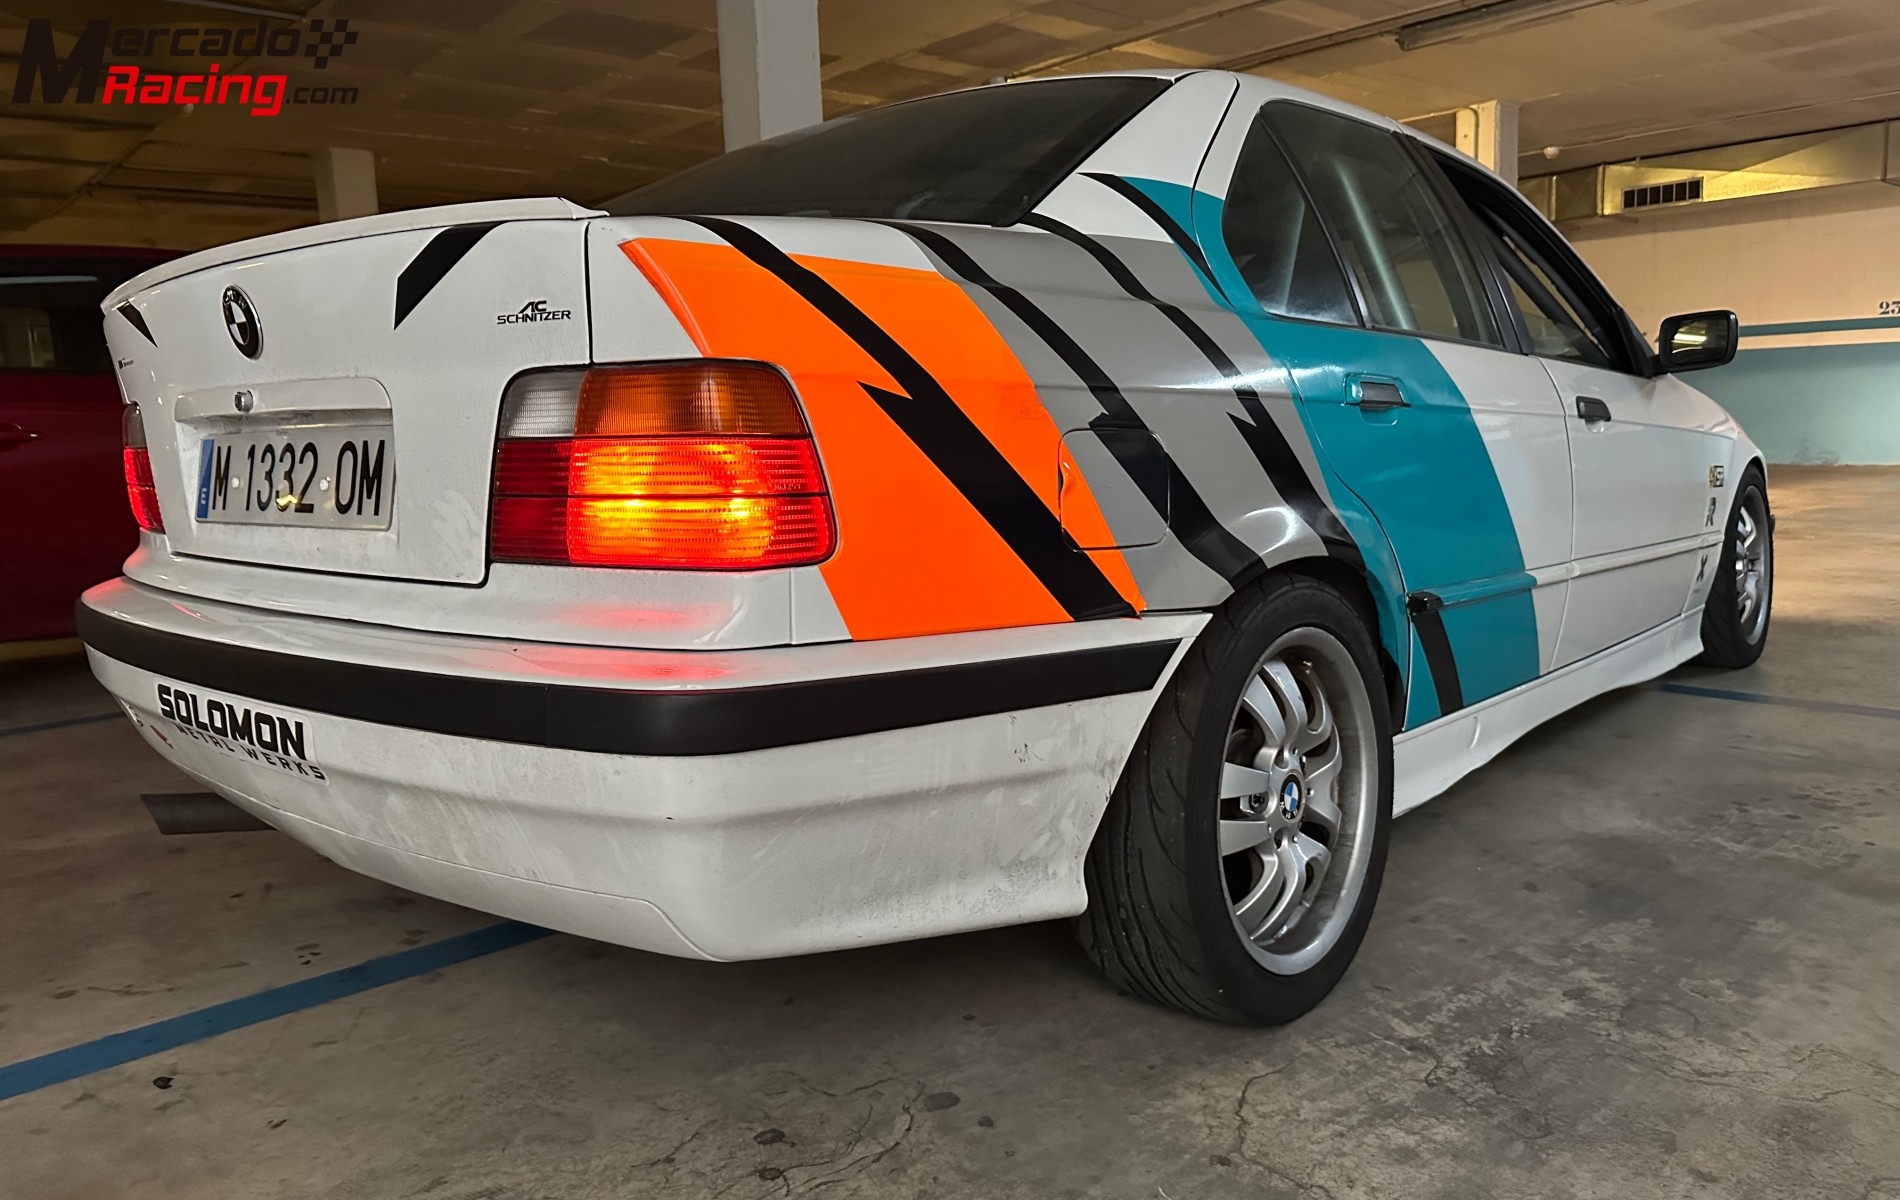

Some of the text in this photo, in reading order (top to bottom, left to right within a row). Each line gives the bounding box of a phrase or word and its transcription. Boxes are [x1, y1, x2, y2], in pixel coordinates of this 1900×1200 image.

[497, 310, 571, 325] SCHNITZER
[518, 300, 547, 314] AC
[211, 439, 386, 517] M 1332 OM
[200, 487, 208, 505] E
[157, 683, 307, 761] SOLOMON
[239, 744, 326, 781] WERKS
